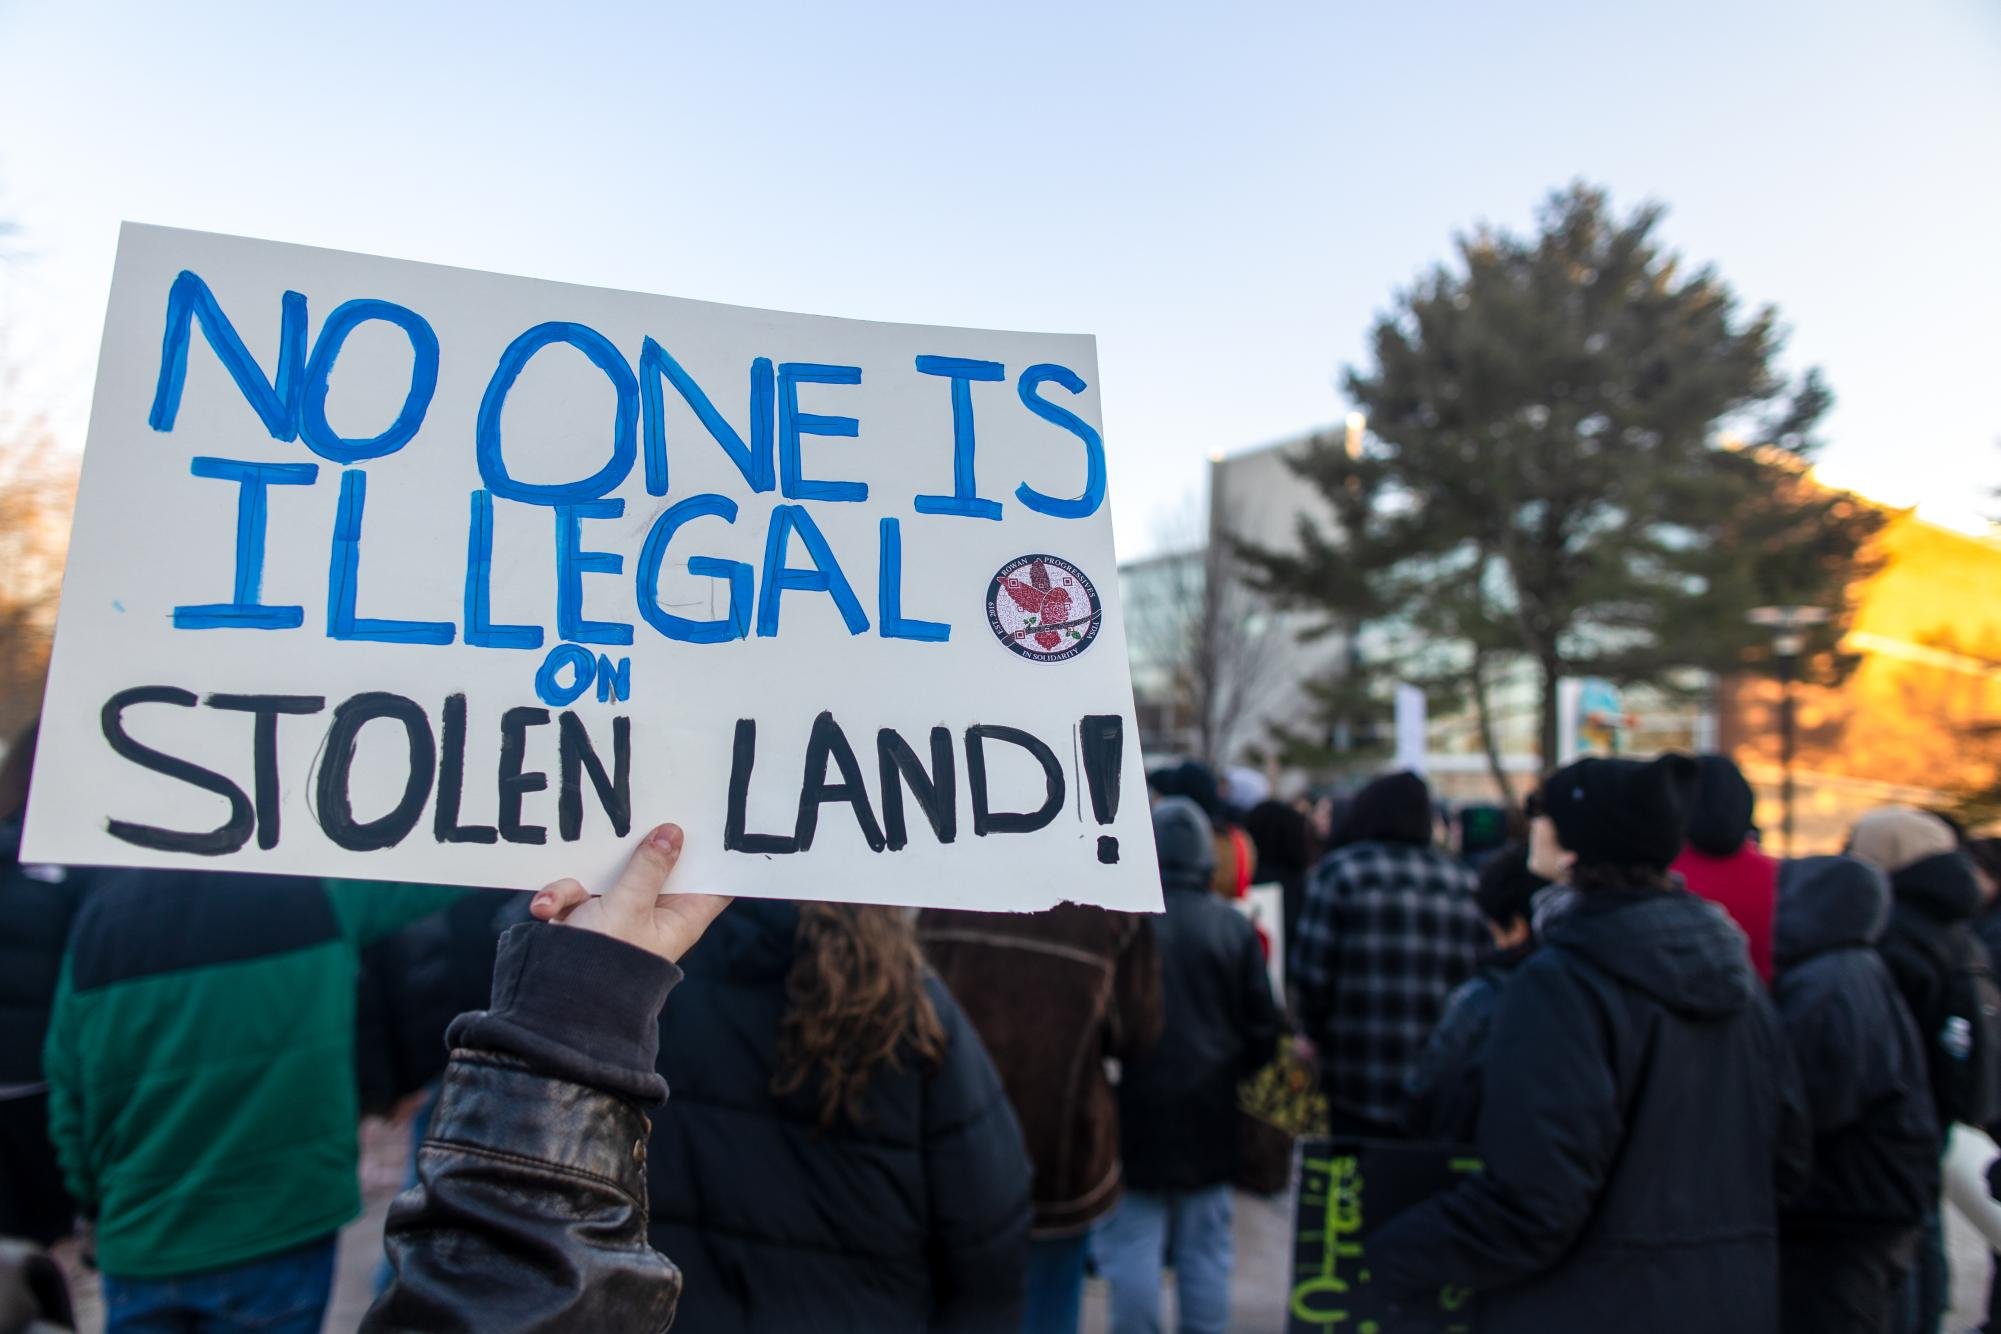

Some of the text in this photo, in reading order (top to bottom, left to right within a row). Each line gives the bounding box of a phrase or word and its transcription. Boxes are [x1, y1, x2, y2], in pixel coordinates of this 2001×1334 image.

[148, 270, 1107, 521] NO ONE IS
[173, 456, 952, 650] ILLEGAL
[988, 601, 1004, 635] EST. 2019
[1001, 556, 1100, 639] ROWAN PROGRESSIVES YDSA
[535, 644, 631, 706] ON
[1022, 647, 1079, 661] IN SOLIDARITY
[102, 685, 1123, 864] STOLEN LAND!
